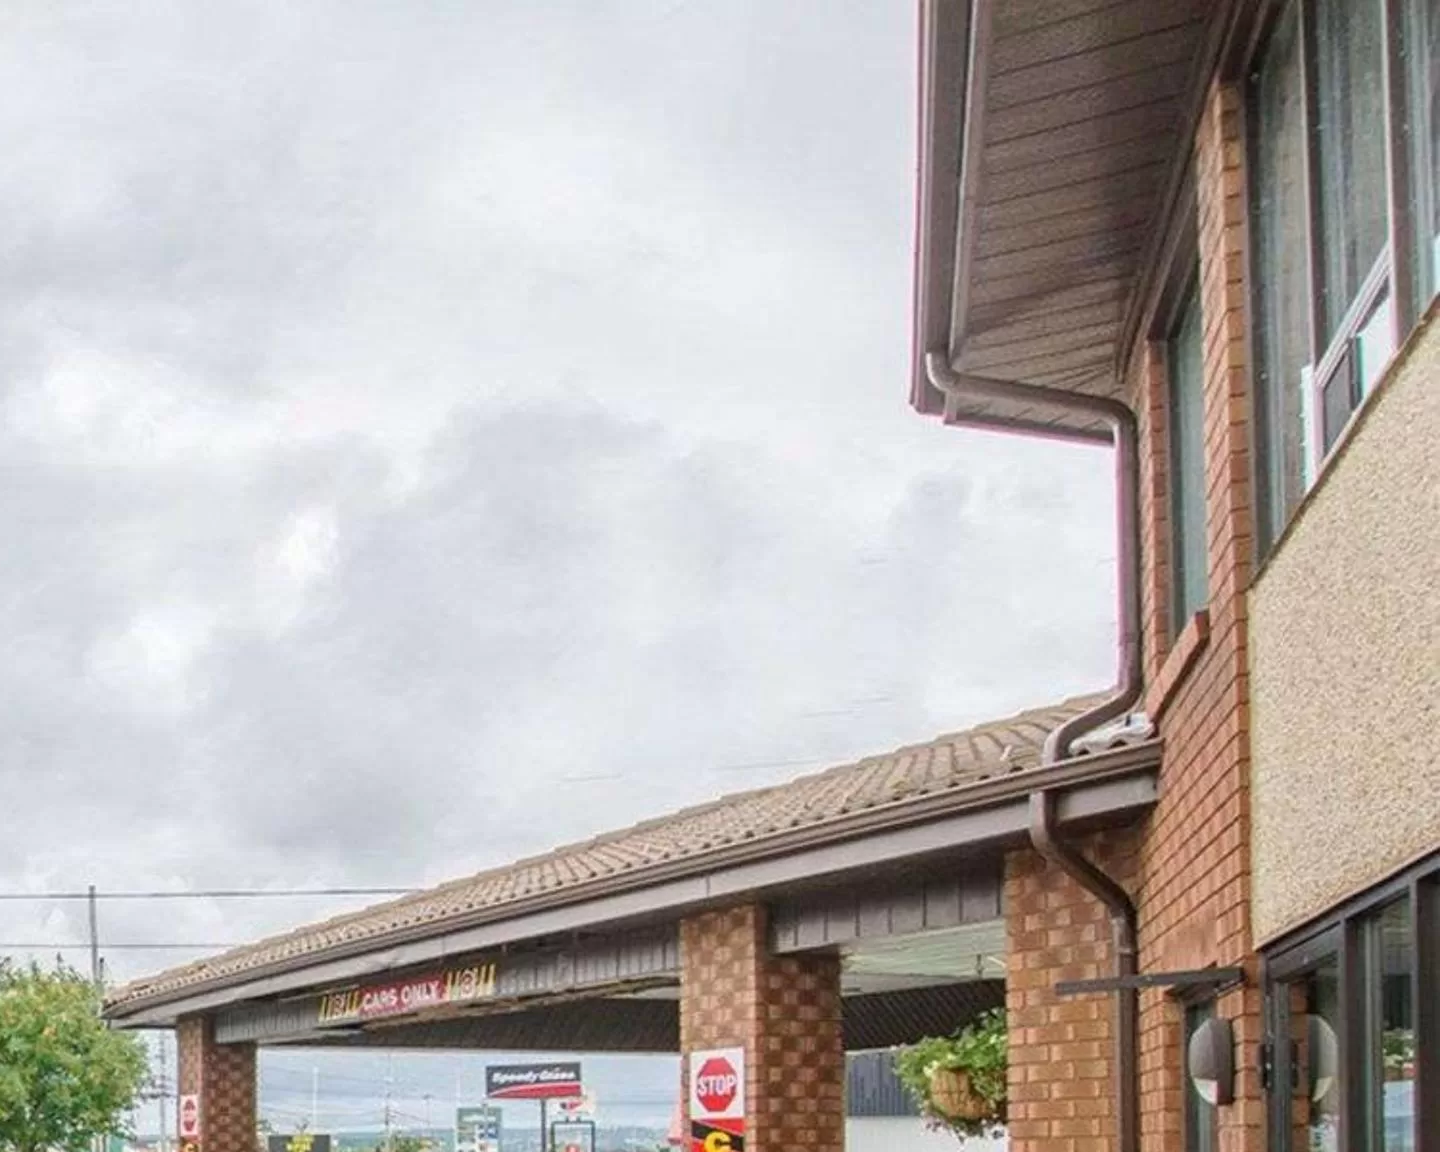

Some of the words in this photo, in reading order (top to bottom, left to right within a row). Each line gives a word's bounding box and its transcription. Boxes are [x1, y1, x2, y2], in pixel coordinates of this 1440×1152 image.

[362, 987, 398, 1011] CARS
[400, 980, 440, 1005] ONLY
[697, 1073, 737, 1097] STOP
